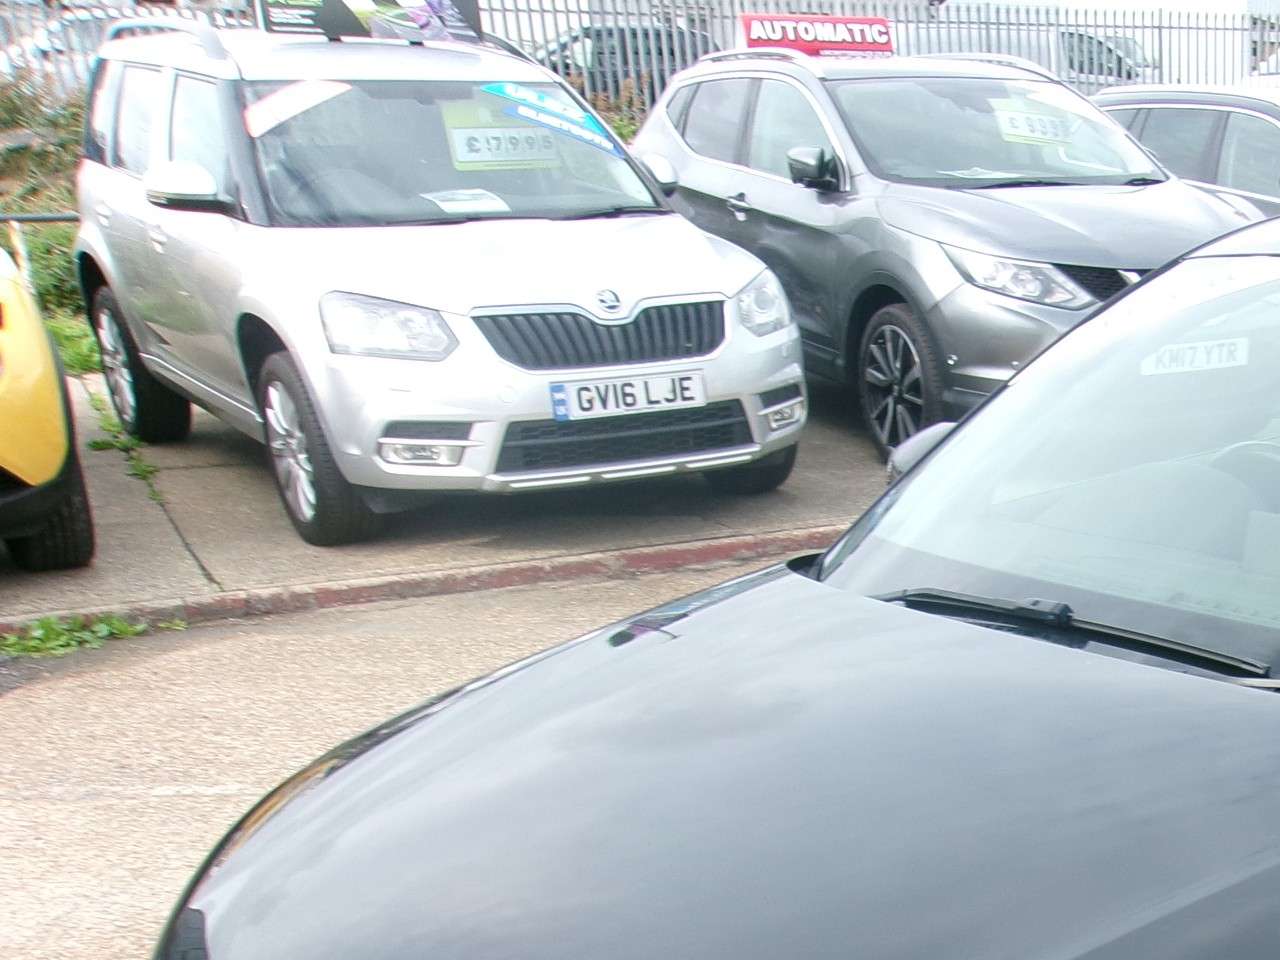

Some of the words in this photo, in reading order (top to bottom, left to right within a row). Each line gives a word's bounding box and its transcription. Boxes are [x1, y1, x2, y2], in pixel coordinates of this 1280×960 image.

[750, 20, 889, 44] AUTOMATIC
[1203, 342, 1238, 365] YTR
[576, 381, 638, 412] GV16
[643, 376, 695, 406] LJE
